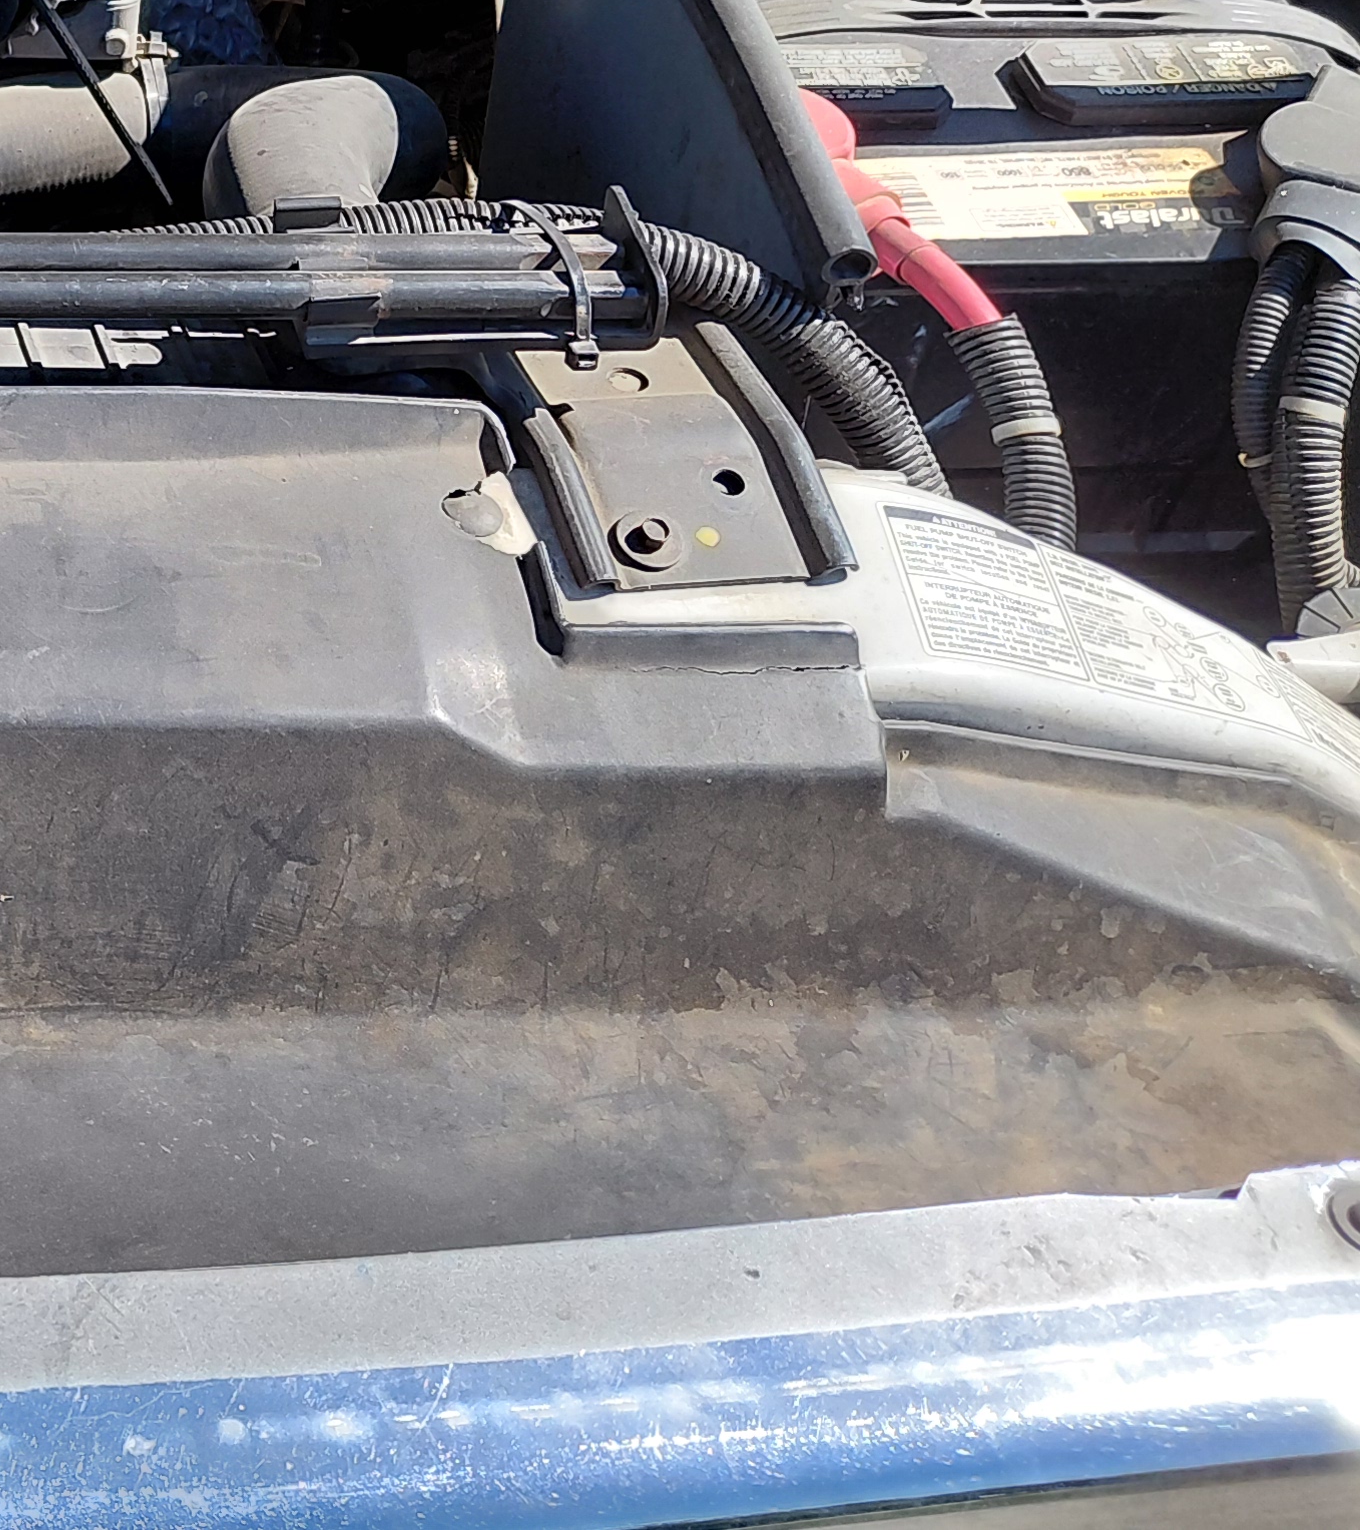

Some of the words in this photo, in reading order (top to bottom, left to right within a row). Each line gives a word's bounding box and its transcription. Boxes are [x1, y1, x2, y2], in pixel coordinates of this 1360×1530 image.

[1097, 83, 1168, 96] POISON
[1184, 82, 1261, 94] DANGER
[1094, 202, 1156, 211] GOLD
[1095, 206, 1245, 230] Duralast
